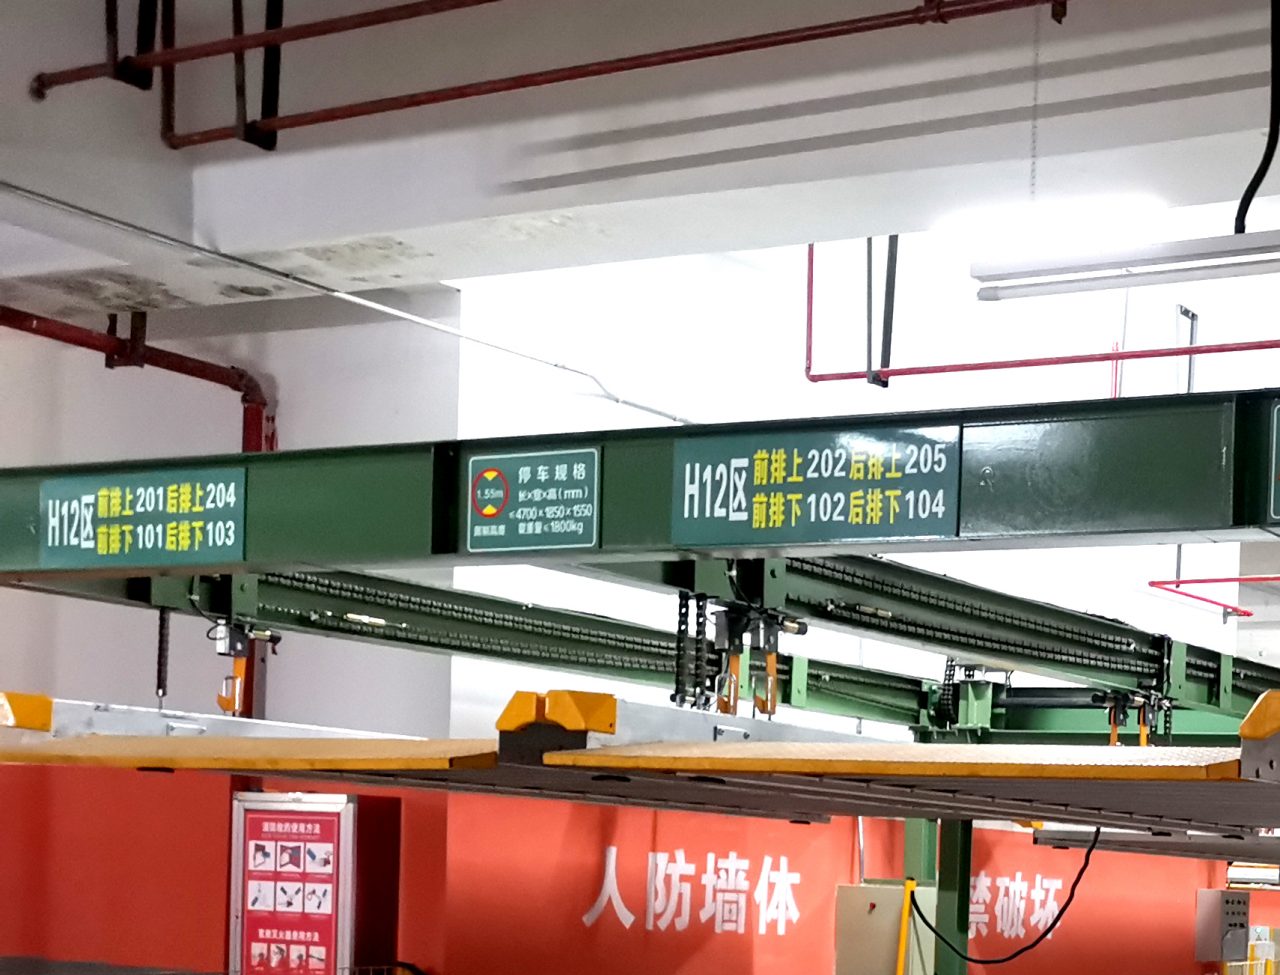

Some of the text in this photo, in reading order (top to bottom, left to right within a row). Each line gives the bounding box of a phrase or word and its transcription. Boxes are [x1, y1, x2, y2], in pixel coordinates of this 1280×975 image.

[518, 462, 586, 484] 停车规格
[753, 443, 947, 485] 前排上202后排上205
[97, 482, 236, 518] 前排上201后排上204
[683, 457, 749, 521] H12区
[752, 488, 945, 529] 前排下102后排下104
[48, 494, 95, 549] H12区
[97, 520, 236, 555] 前排下101后排下103
[581, 846, 800, 935] 人防墙体
